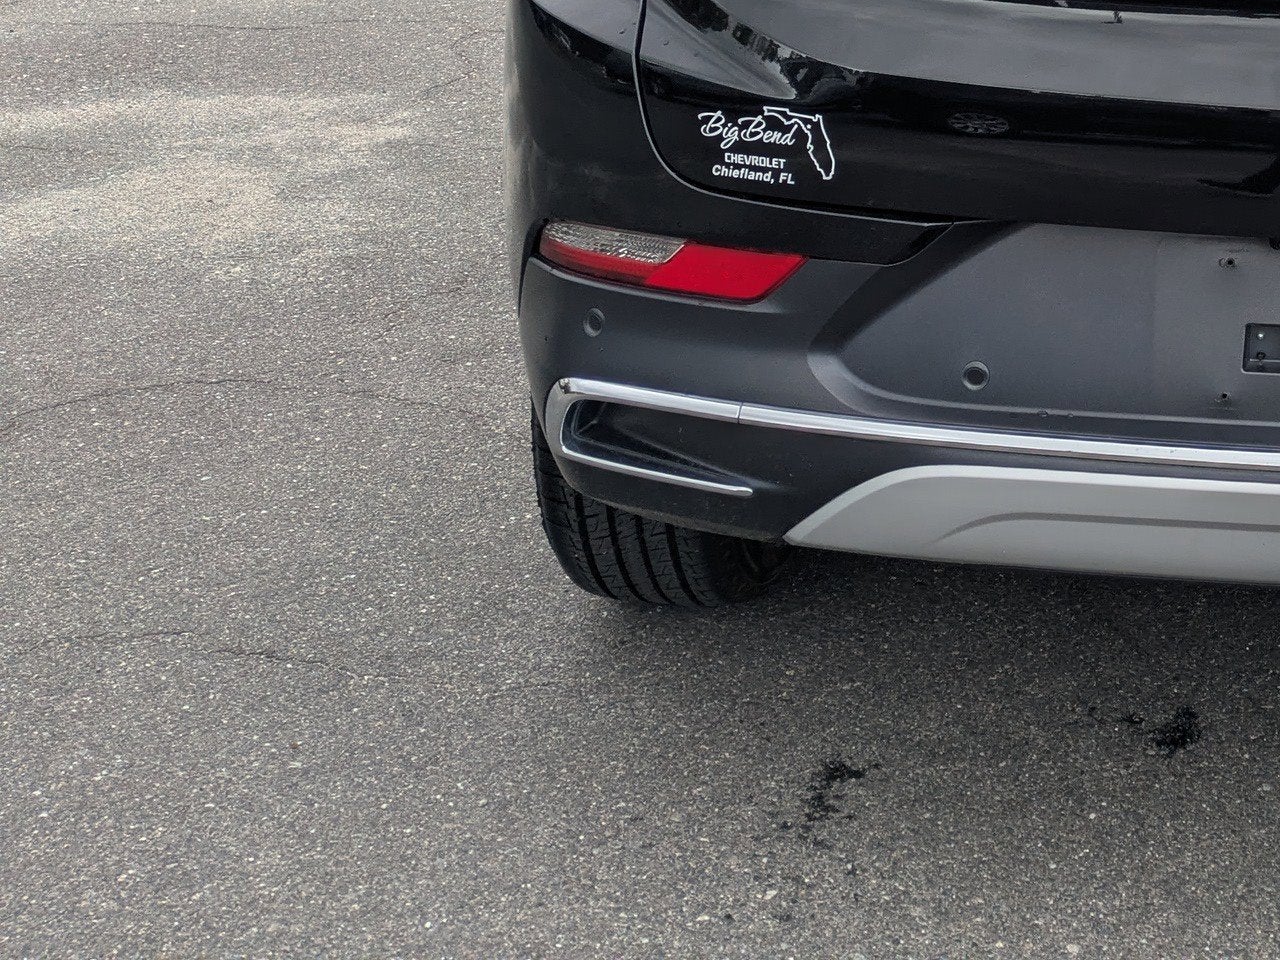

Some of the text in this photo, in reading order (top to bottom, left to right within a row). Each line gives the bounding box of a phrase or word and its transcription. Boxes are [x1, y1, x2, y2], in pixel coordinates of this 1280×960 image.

[698, 110, 798, 149] Big Bend
[724, 152, 786, 169] CHEVROLET
[712, 164, 795, 184] Chiefland, FL
